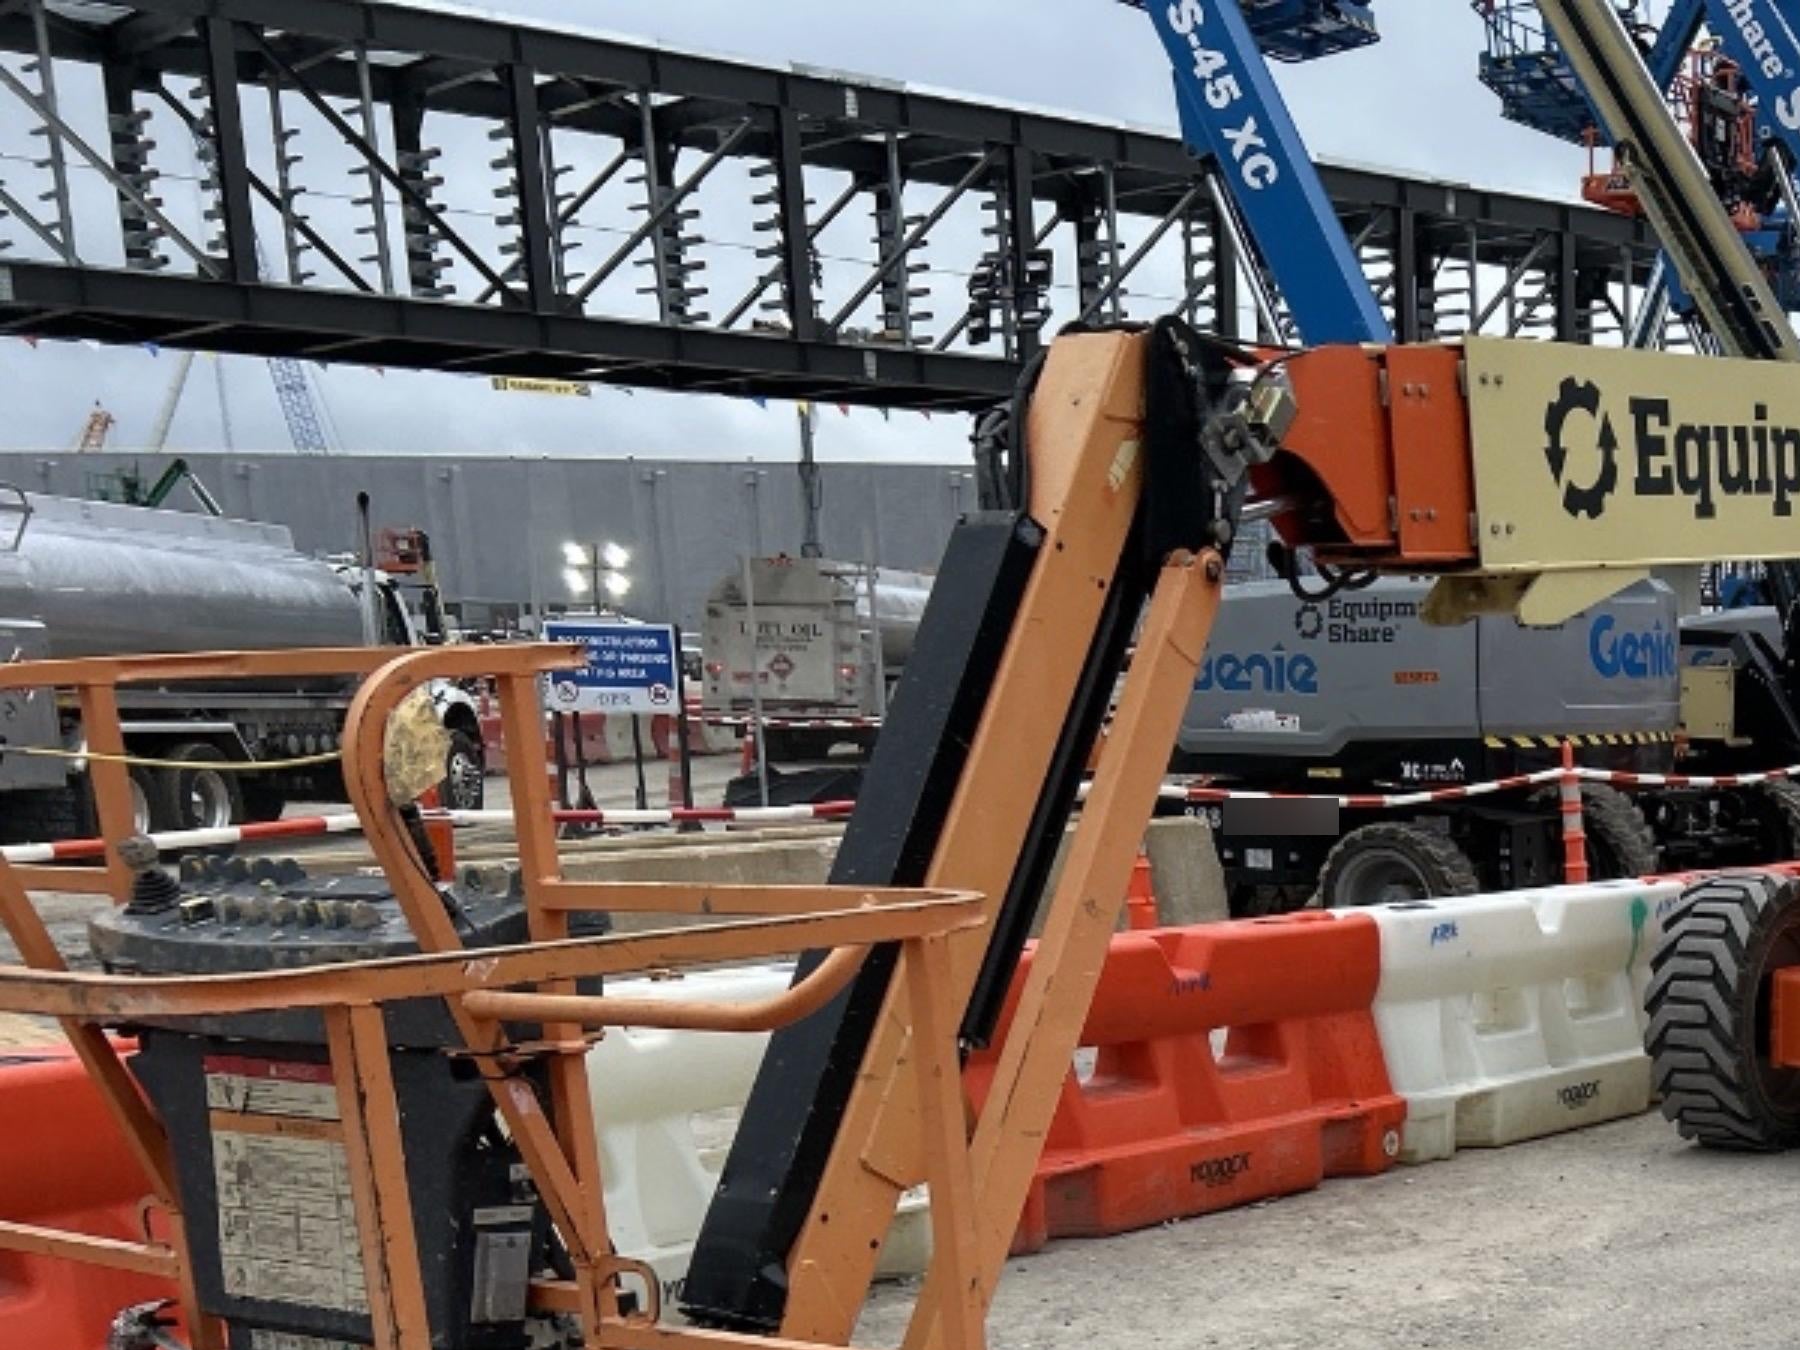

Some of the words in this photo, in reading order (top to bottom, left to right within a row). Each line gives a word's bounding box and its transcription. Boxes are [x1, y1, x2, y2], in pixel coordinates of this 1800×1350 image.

[1167, 0, 1242, 109] S-45
[1220, 116, 1279, 190] XC
[1328, 623, 1394, 643] Share
[1589, 614, 1677, 678] Genie
